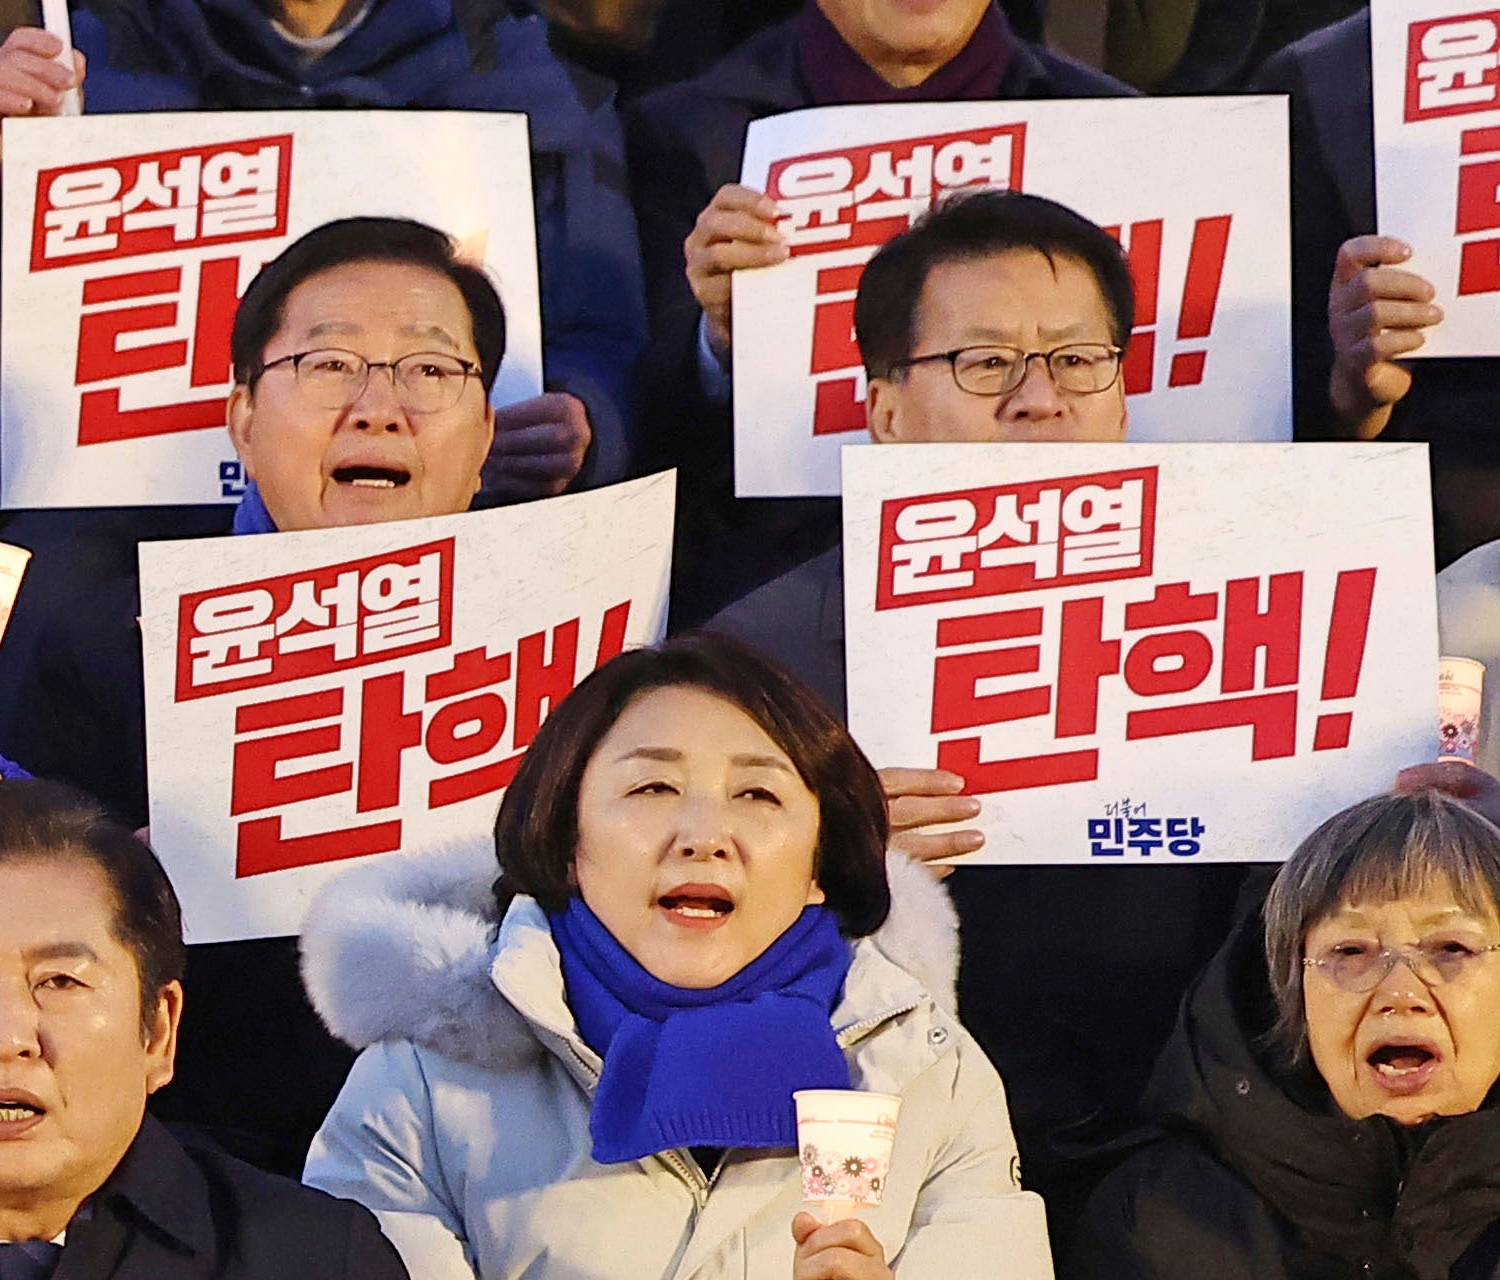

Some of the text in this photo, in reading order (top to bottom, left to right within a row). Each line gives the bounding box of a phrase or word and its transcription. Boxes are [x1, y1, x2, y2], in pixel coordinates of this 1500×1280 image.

[44, 147, 278, 258] 윤석열
[893, 479, 1145, 593] 윤석열
[190, 551, 441, 686] 윤석열
[932, 568, 1377, 796] 탄핵!
[1088, 817, 1205, 856] 민주당
[1104, 798, 1147, 817] 더불어
